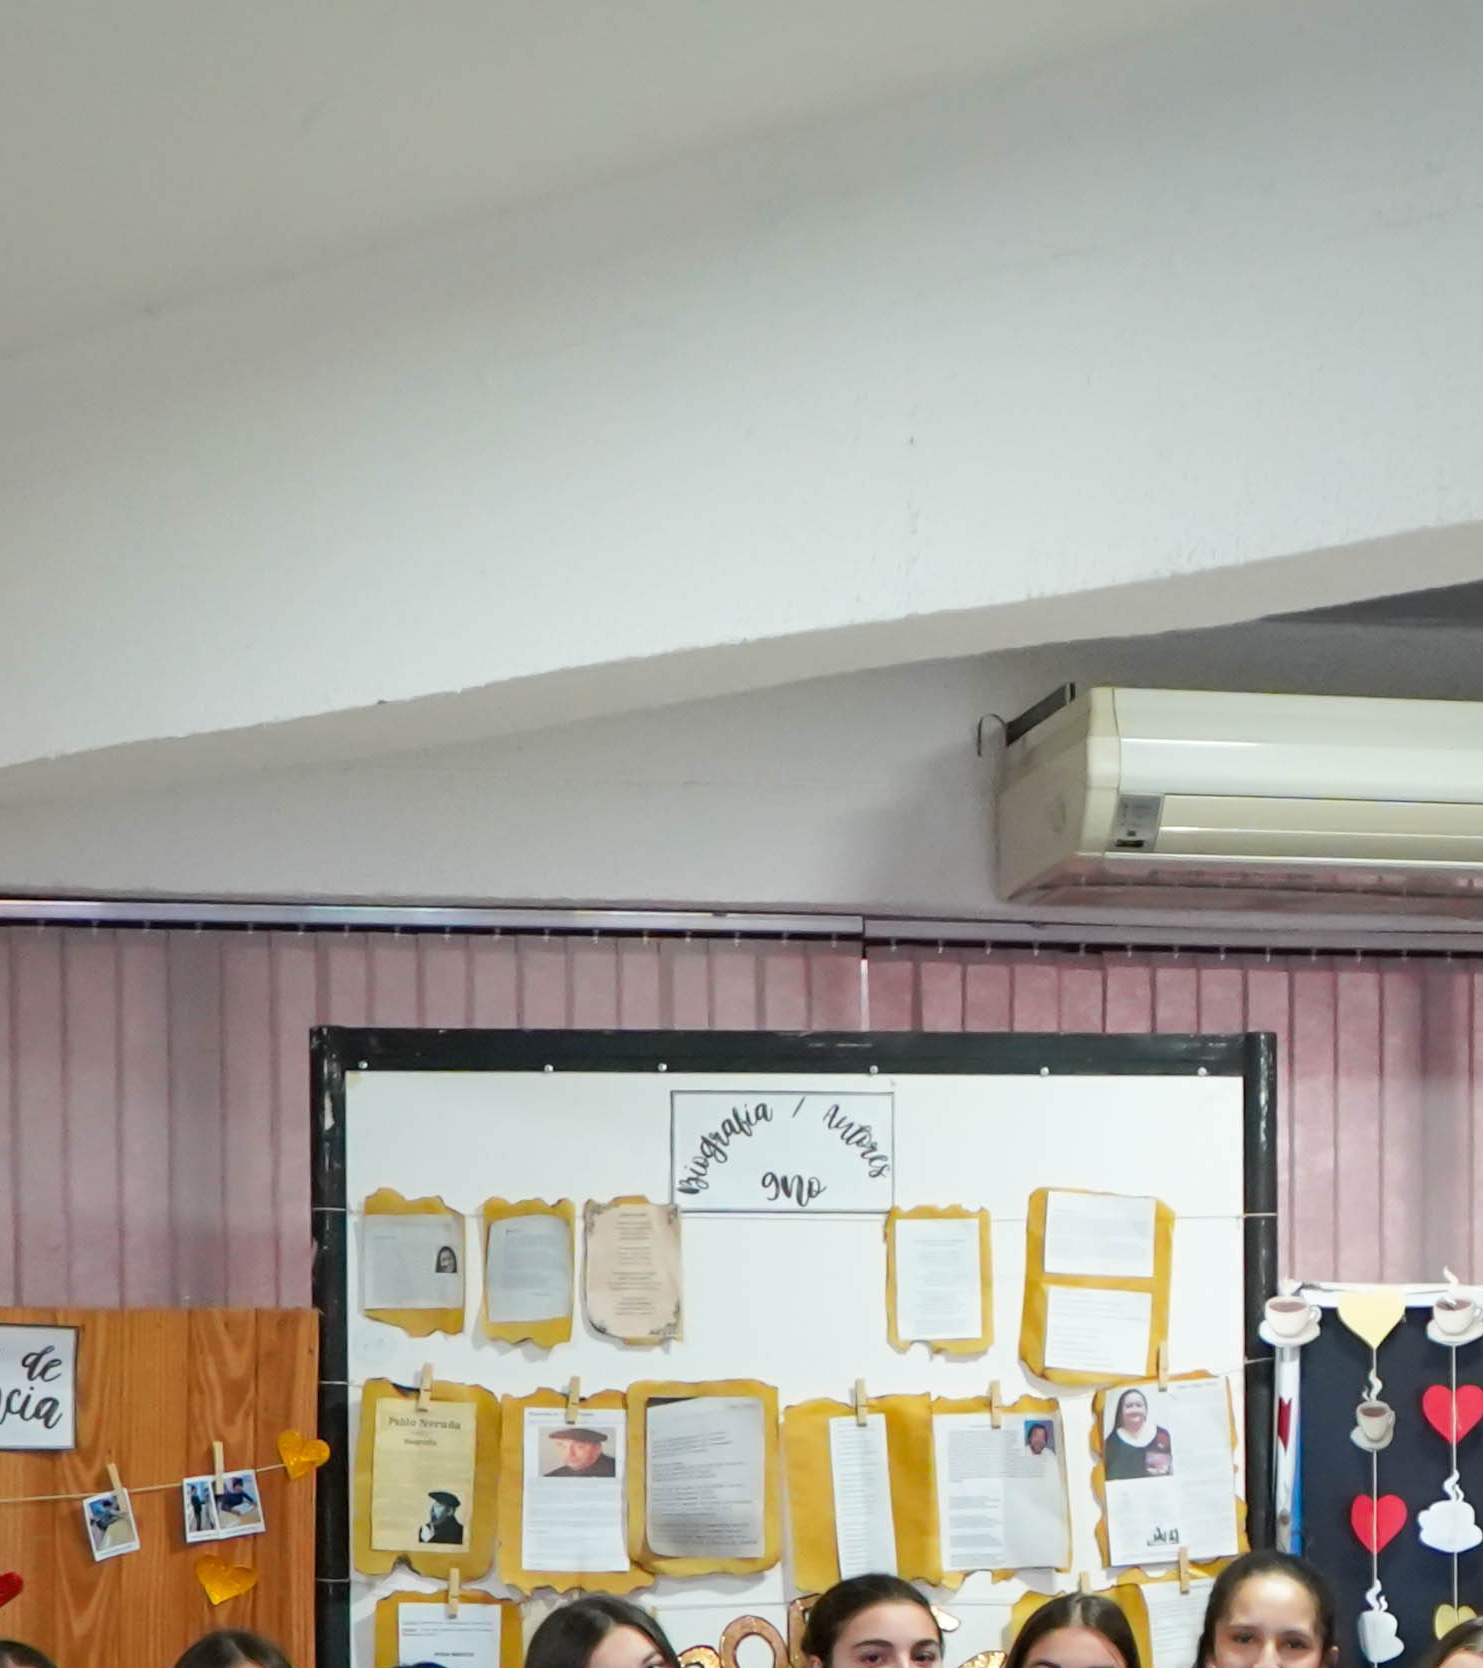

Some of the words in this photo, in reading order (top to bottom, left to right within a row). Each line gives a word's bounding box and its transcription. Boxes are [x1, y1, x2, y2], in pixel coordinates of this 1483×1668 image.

[822, 1103, 891, 1178] Autores
[21, 1345, 62, 1382] de
[388, 1415, 416, 1427] Pablo
[419, 1417, 462, 1430] Neruda
